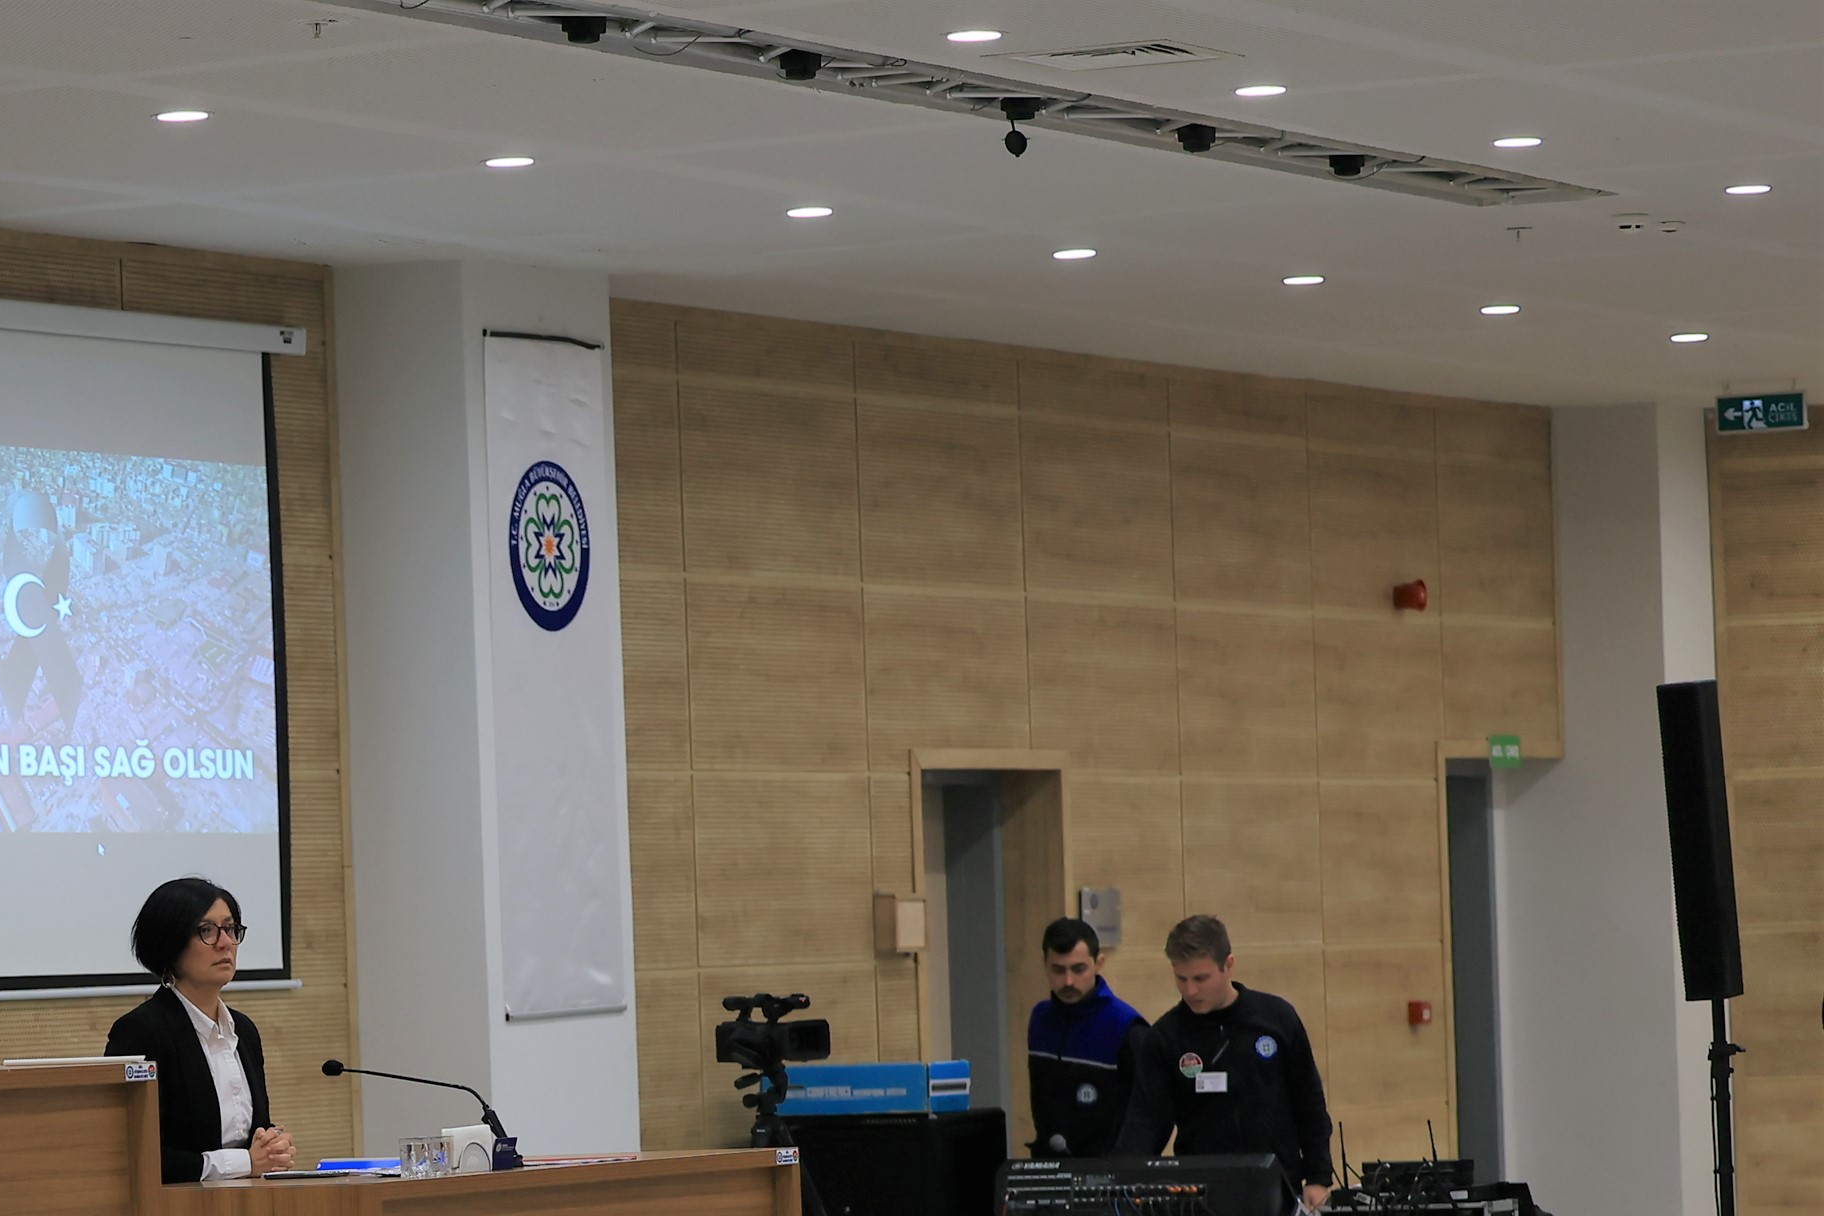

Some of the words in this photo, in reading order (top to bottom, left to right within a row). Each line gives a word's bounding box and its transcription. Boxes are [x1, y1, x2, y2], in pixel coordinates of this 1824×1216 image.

[18, 745, 85, 786] BAŞI
[93, 739, 156, 779] SAĞ
[163, 747, 255, 780] OLSUN
